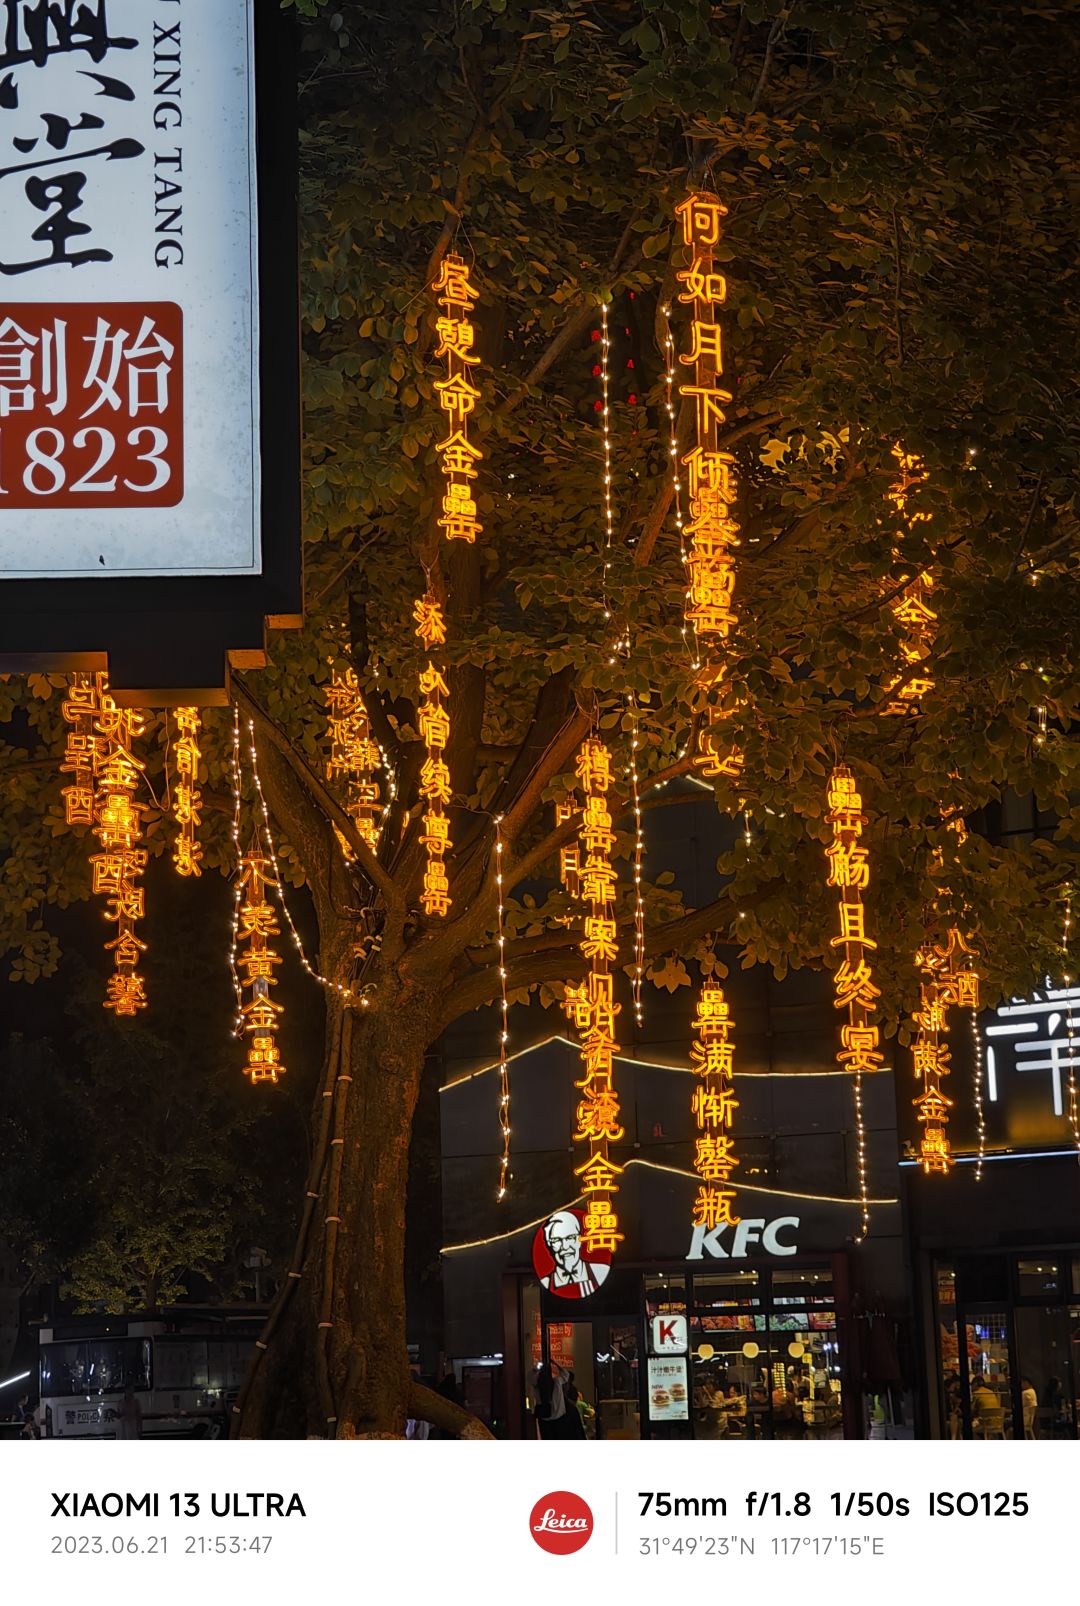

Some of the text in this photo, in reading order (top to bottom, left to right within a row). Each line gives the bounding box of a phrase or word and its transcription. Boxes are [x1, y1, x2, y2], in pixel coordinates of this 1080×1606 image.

[153, 21, 183, 131] XING
[154, 147, 184, 269] TANG
[0, 316, 176, 418] 創始
[432, 259, 483, 543] 昼憩命金罍
[0, 427, 172, 494] 823
[824, 775, 884, 1072] 罍觞且终宴
[685, 1216, 800, 1260] KFC
[659, 1320, 678, 1345] K
